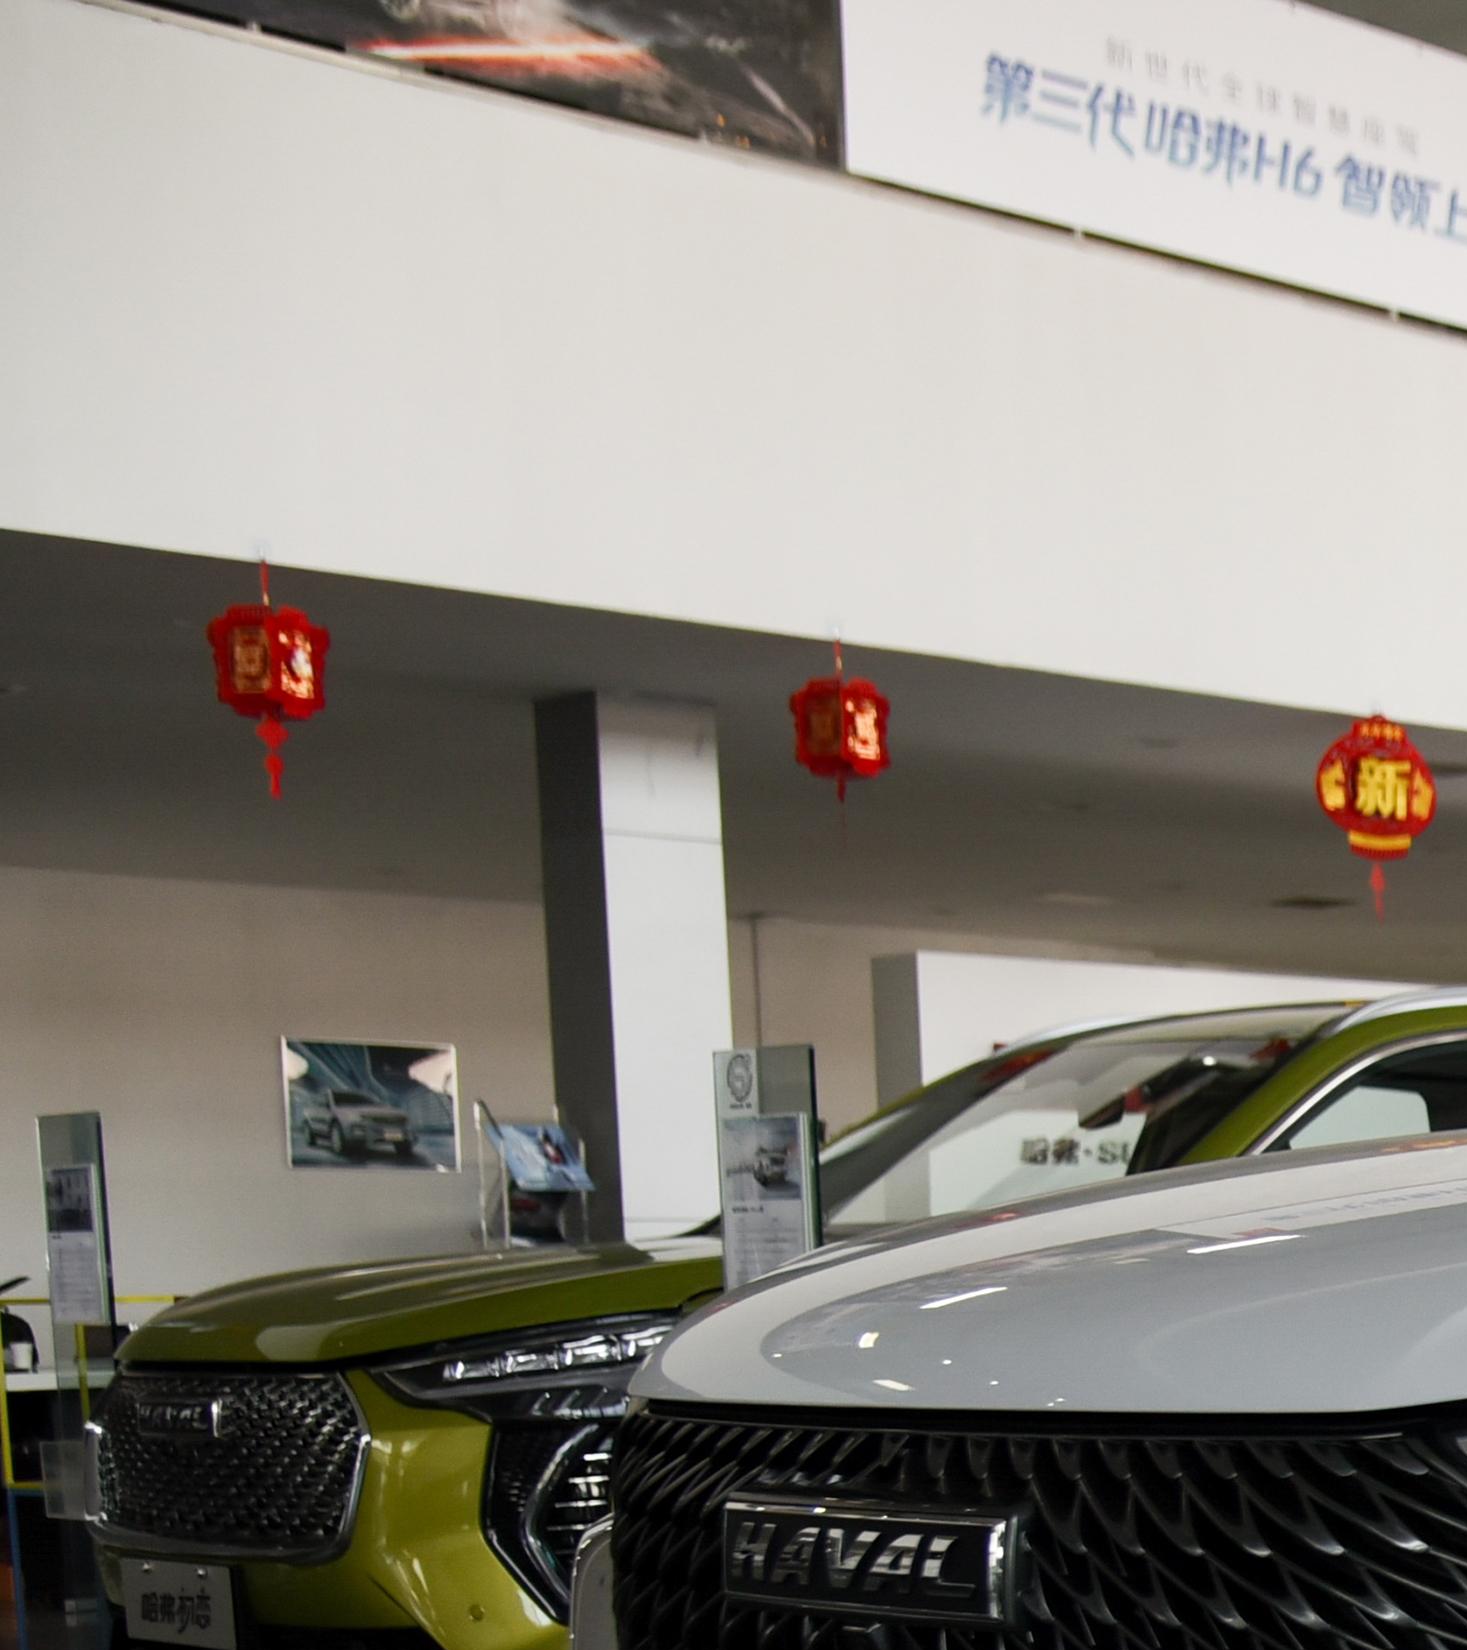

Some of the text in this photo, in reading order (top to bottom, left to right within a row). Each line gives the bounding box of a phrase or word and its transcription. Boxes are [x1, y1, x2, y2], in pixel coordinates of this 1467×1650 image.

[1356, 756, 1411, 821] 新
[730, 1521, 976, 1598] HAVAL
[141, 1587, 212, 1635] 哈弗初恋
